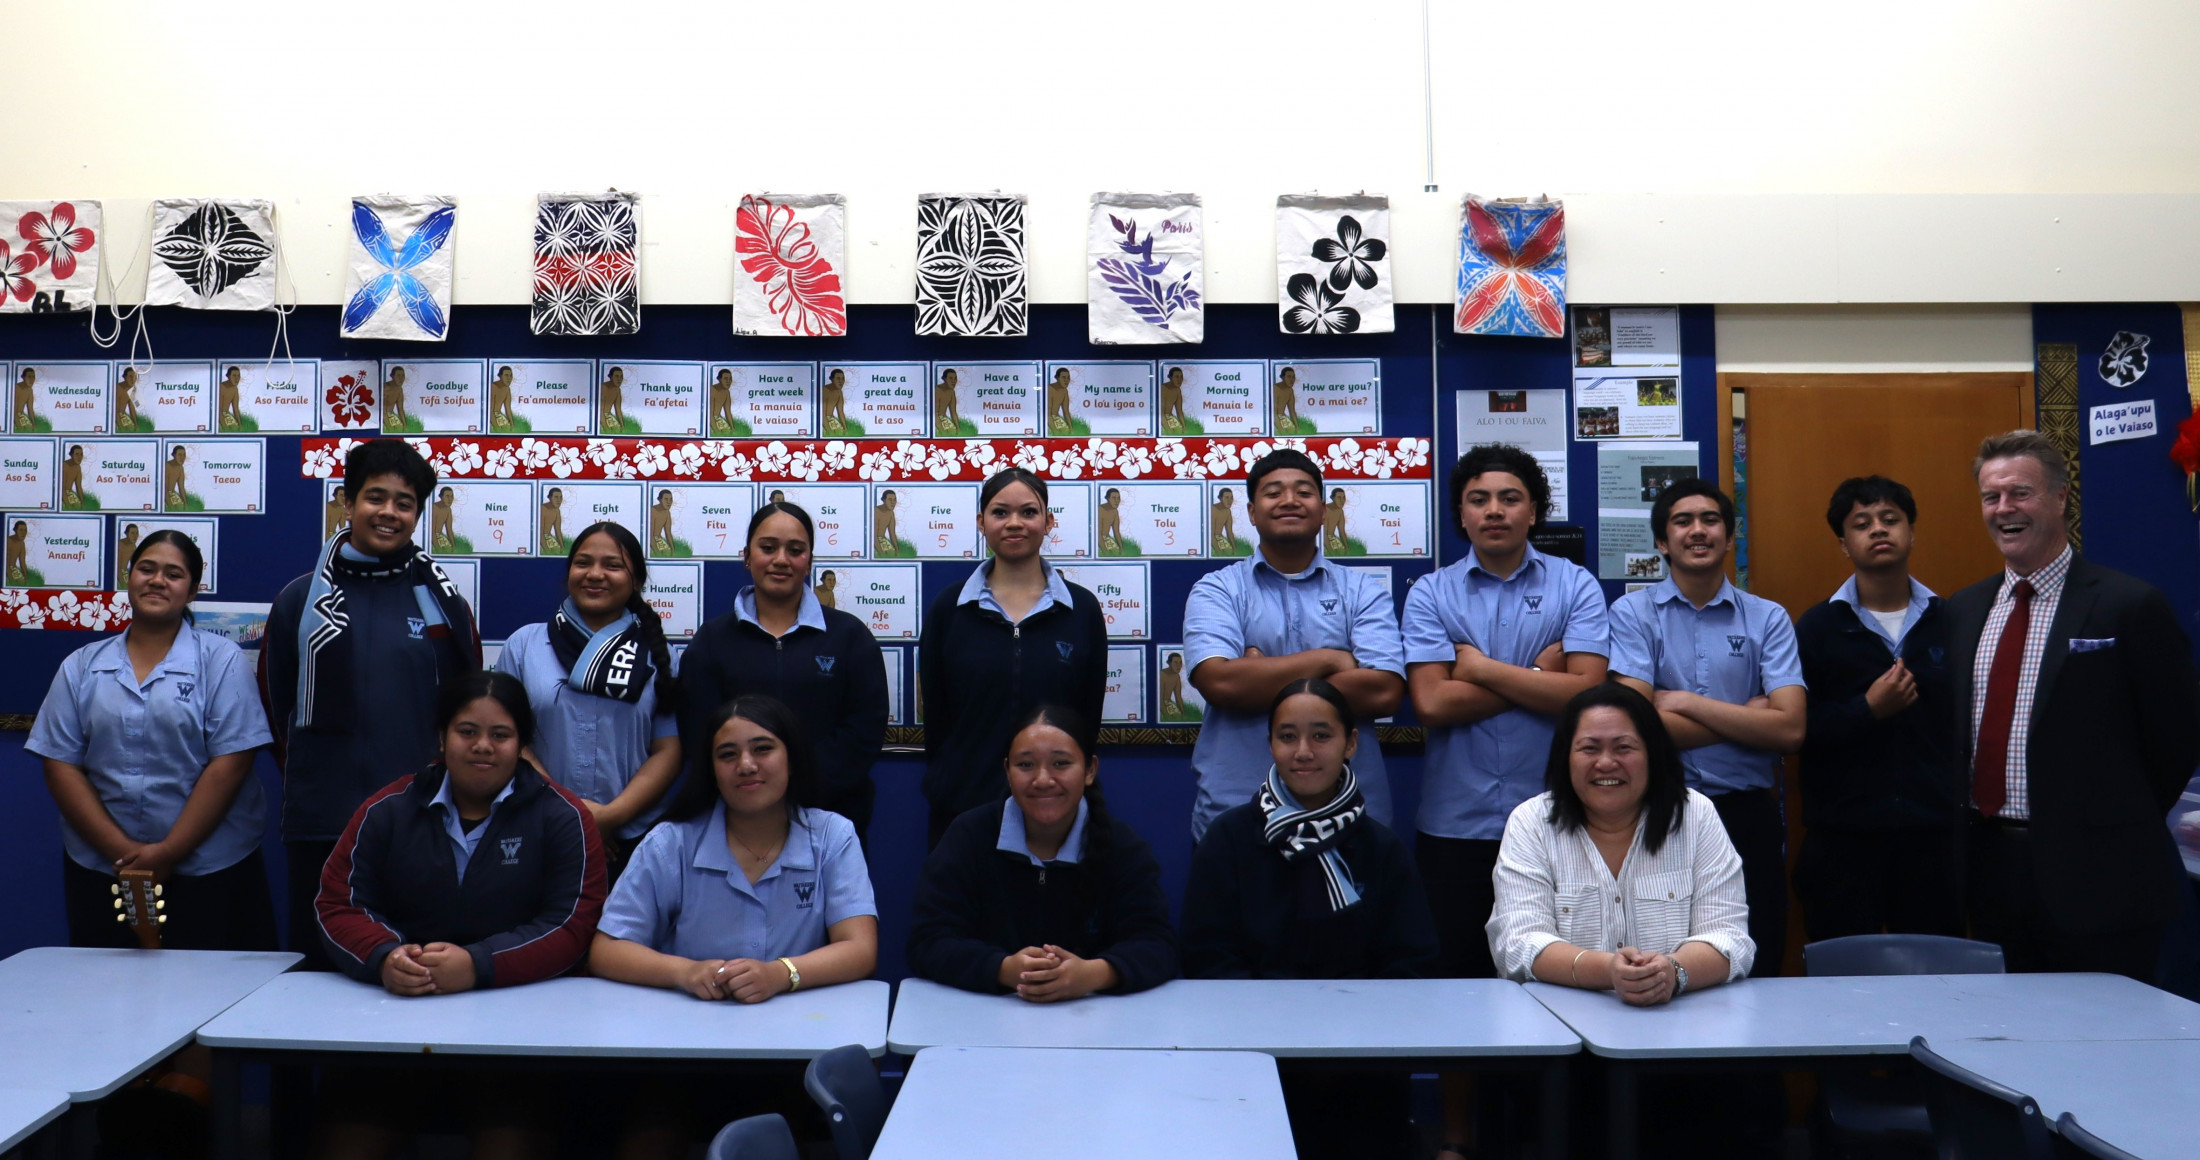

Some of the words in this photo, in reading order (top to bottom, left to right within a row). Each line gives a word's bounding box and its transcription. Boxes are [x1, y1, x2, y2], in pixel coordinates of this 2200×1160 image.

[1161, 219, 1193, 234] Paris
[1215, 372, 1240, 381] Good
[155, 382, 199, 392] Thursday
[426, 381, 468, 392] Goodbye
[537, 381, 567, 389] Please
[640, 383, 671, 391] Thank
[675, 385, 692, 394] you
[1085, 385, 1099, 395] My
[1135, 384, 1142, 393] is
[1303, 383, 1325, 391] How
[1328, 383, 1345, 391] are
[1349, 382, 1371, 393] you?
[49, 386, 101, 397] Wednesday
[749, 389, 775, 398] great
[778, 387, 803, 396] week
[865, 389, 891, 398] great
[895, 387, 913, 398] day
[977, 387, 1003, 397] great
[1007, 386, 1026, 397] day
[1207, 386, 1248, 396] Morning
[179, 396, 195, 407] Tofi
[255, 396, 272, 404] Aso
[276, 396, 308, 404] Faraile
[444, 396, 474, 407] Soifua
[519, 395, 586, 404] Fa'amolemole
[645, 398, 687, 409] Fa'afetai
[1203, 401, 1240, 409] Manuia
[1245, 400, 1253, 409] le
[1308, 398, 1315, 406] O
[1329, 397, 1347, 405] mai
[55, 401, 71, 409] Aso
[764, 402, 802, 410] manuia
[877, 402, 915, 410] manuia
[1083, 400, 1090, 408] O
[1114, 400, 1135, 410] igoa
[2095, 405, 2151, 420] Alaga'upu
[754, 416, 762, 424] le
[766, 416, 798, 424] vaiaso
[875, 416, 883, 424] le
[984, 414, 998, 423] lou
[1002, 416, 1021, 424] aso
[2096, 428, 2103, 437] o
[2105, 425, 2116, 436] le
[2119, 421, 2153, 433] Vaiaso
[4, 459, 38, 470] Sunday
[102, 460, 145, 471] Saturday
[203, 461, 251, 469] Tomorrow
[96, 475, 113, 483] Aso
[117, 474, 149, 483] To'onai
[486, 503, 507, 511] Nine
[593, 504, 618, 515] Eight
[702, 506, 731, 514] Seven
[821, 506, 836, 514] Six
[931, 506, 951, 514] Five
[1047, 506, 1065, 514] our
[1151, 504, 1179, 512] Three
[1381, 504, 1400, 512] One
[489, 518, 504, 526] Iva
[707, 521, 726, 529] Fitu
[929, 521, 953, 529] Lima
[1155, 519, 1176, 527] Tolu
[1380, 518, 1400, 527] Tasi
[493, 530, 503, 544] 9
[715, 534, 726, 548] 7
[828, 533, 837, 545] 6
[939, 534, 948, 548] 5
[1050, 534, 1063, 547] 4
[1164, 531, 1174, 545] 3
[1391, 532, 1401, 545] 1
[45, 537, 89, 548] Yesterday
[48, 550, 85, 562] 'Ananafi
[650, 584, 693, 593] Hundred
[870, 582, 891, 591] One
[1097, 584, 1121, 596] Fifty
[855, 595, 906, 605] Thousand
[1107, 598, 1140, 611] Sefulu
[872, 610, 889, 622] Afe
